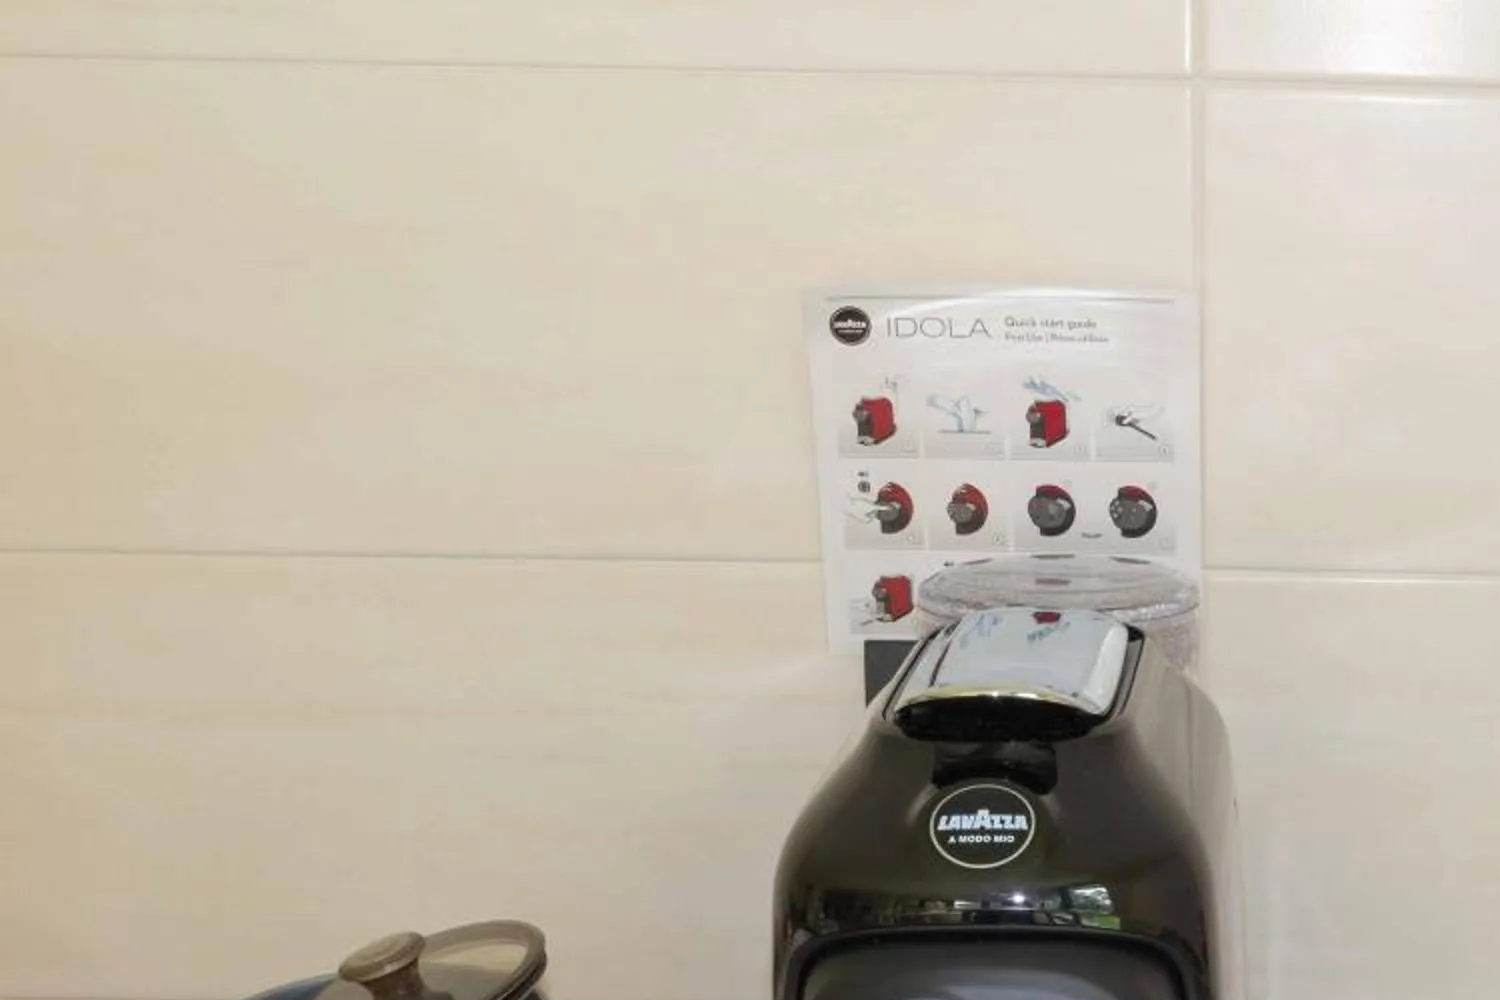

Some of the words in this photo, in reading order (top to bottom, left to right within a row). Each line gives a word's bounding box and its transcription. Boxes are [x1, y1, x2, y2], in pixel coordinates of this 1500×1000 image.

[886, 316, 993, 339] IDOLA
[937, 809, 1029, 831] LAVAZZA
[958, 835, 992, 843] MODO
[993, 835, 1015, 843] MIO
